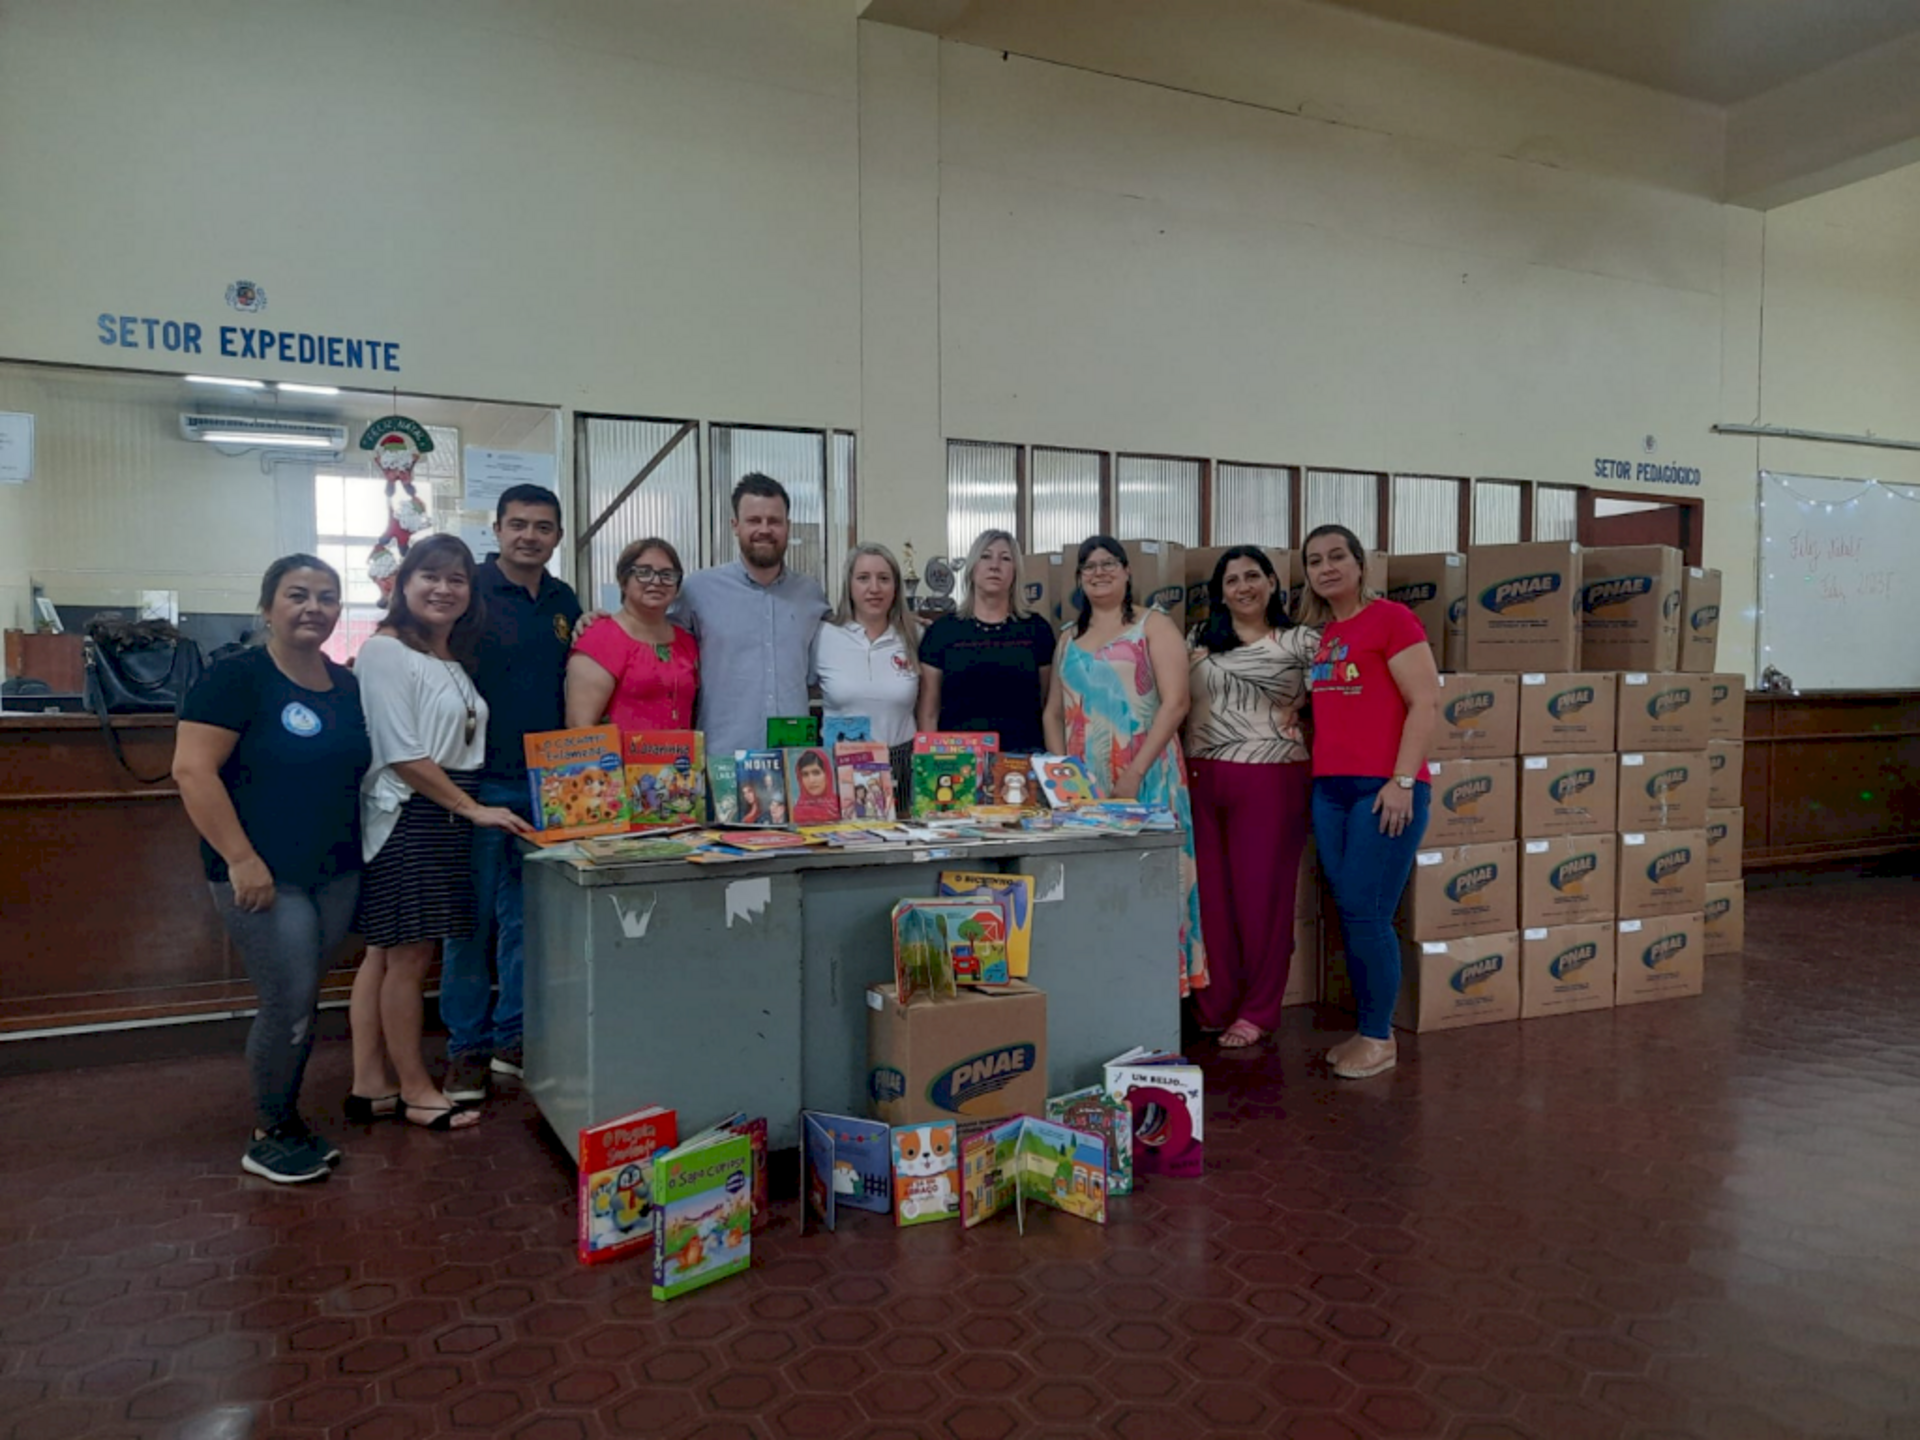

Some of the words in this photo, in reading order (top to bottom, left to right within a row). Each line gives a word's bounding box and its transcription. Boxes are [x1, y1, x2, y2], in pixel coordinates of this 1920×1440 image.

[97, 313, 203, 354] SETOR
[219, 325, 401, 372] EXPEDIENTE
[366, 419, 393, 444] FELIZ
[397, 418, 423, 443] NATAL
[1594, 458, 1632, 480] SETOR
[1636, 461, 1702, 486] PEDAGÓGICO
[1495, 576, 1553, 603] PNAE
[1588, 577, 1645, 604] PNAE
[1454, 694, 1490, 717] PNAE
[1556, 690, 1590, 713] PNAE
[1656, 692, 1688, 711] PNAE
[743, 758, 780, 771] NOITE
[1452, 779, 1488, 804] PNAE
[1558, 771, 1591, 795] PNAE
[1559, 856, 1593, 882] PNAE
[1655, 852, 1687, 874] PNAE
[954, 874, 963, 883] O
[1456, 866, 1493, 894] PNAE
[1559, 946, 1593, 972] PNAE
[1651, 937, 1684, 961] PNAE
[1461, 957, 1499, 985] PNAE
[874, 1069, 902, 1093] PNAE
[951, 1047, 1026, 1096] PNAE
[1132, 1073, 1148, 1083] UM
[678, 1169, 705, 1187] Sapo
[706, 1157, 746, 1177] Curioso
